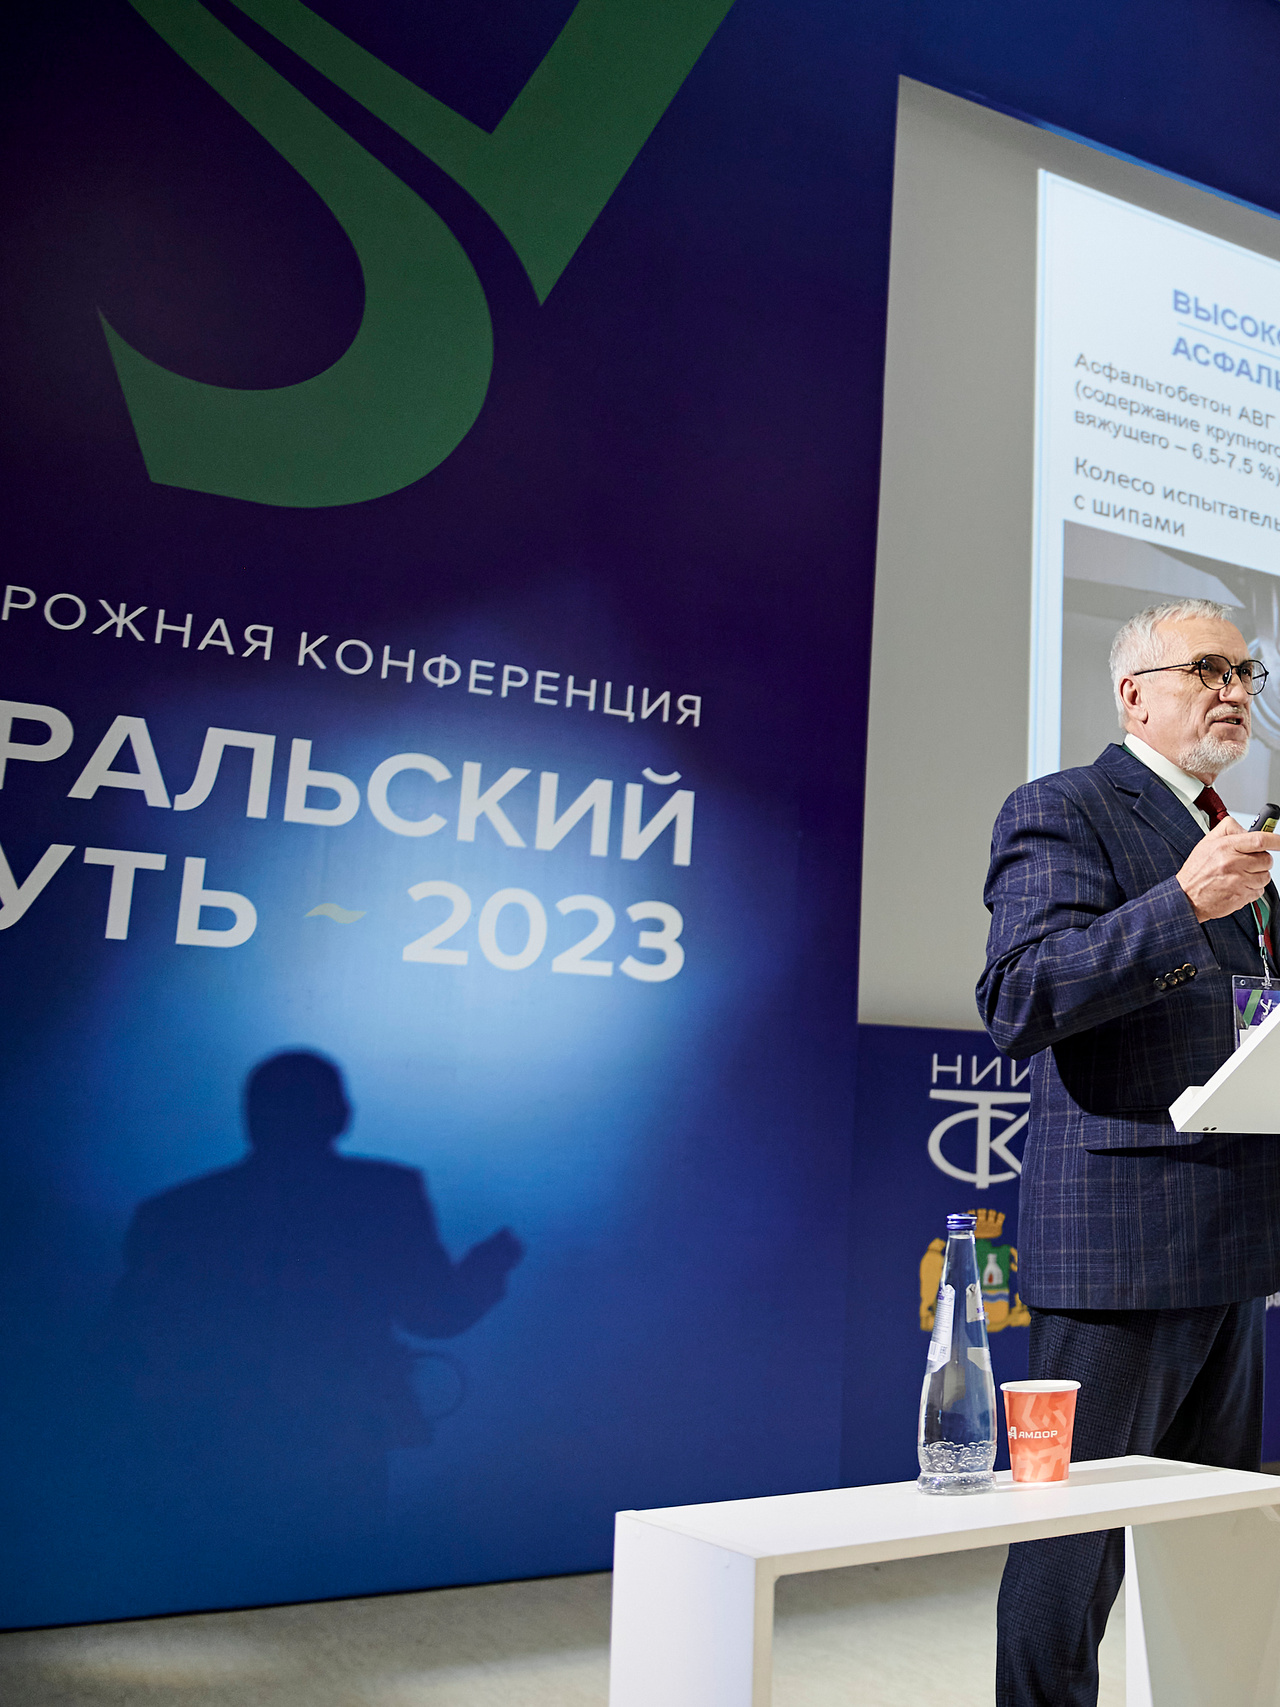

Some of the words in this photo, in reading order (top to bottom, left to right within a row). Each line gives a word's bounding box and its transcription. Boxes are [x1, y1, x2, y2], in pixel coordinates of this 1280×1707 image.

[1074, 352, 1232, 417] Асфальтобетон
[1238, 406, 1276, 430] АВГ
[1074, 379, 1201, 433] (содержание
[1074, 410, 1170, 450] вяжущего
[1258, 460, 1280, 487] %)
[1074, 456, 1156, 496] Колесо
[1073, 493, 1086, 510] с
[1092, 496, 1187, 538] шипами
[0, 585, 275, 661] РОЖНАЯ
[297, 631, 702, 727] КОНФЕРЕНЦИЯ
[0, 700, 696, 866] РАЛЬСКИЙ
[401, 879, 686, 983] 2023
[1018, 1430, 1058, 1439] АМДОР
